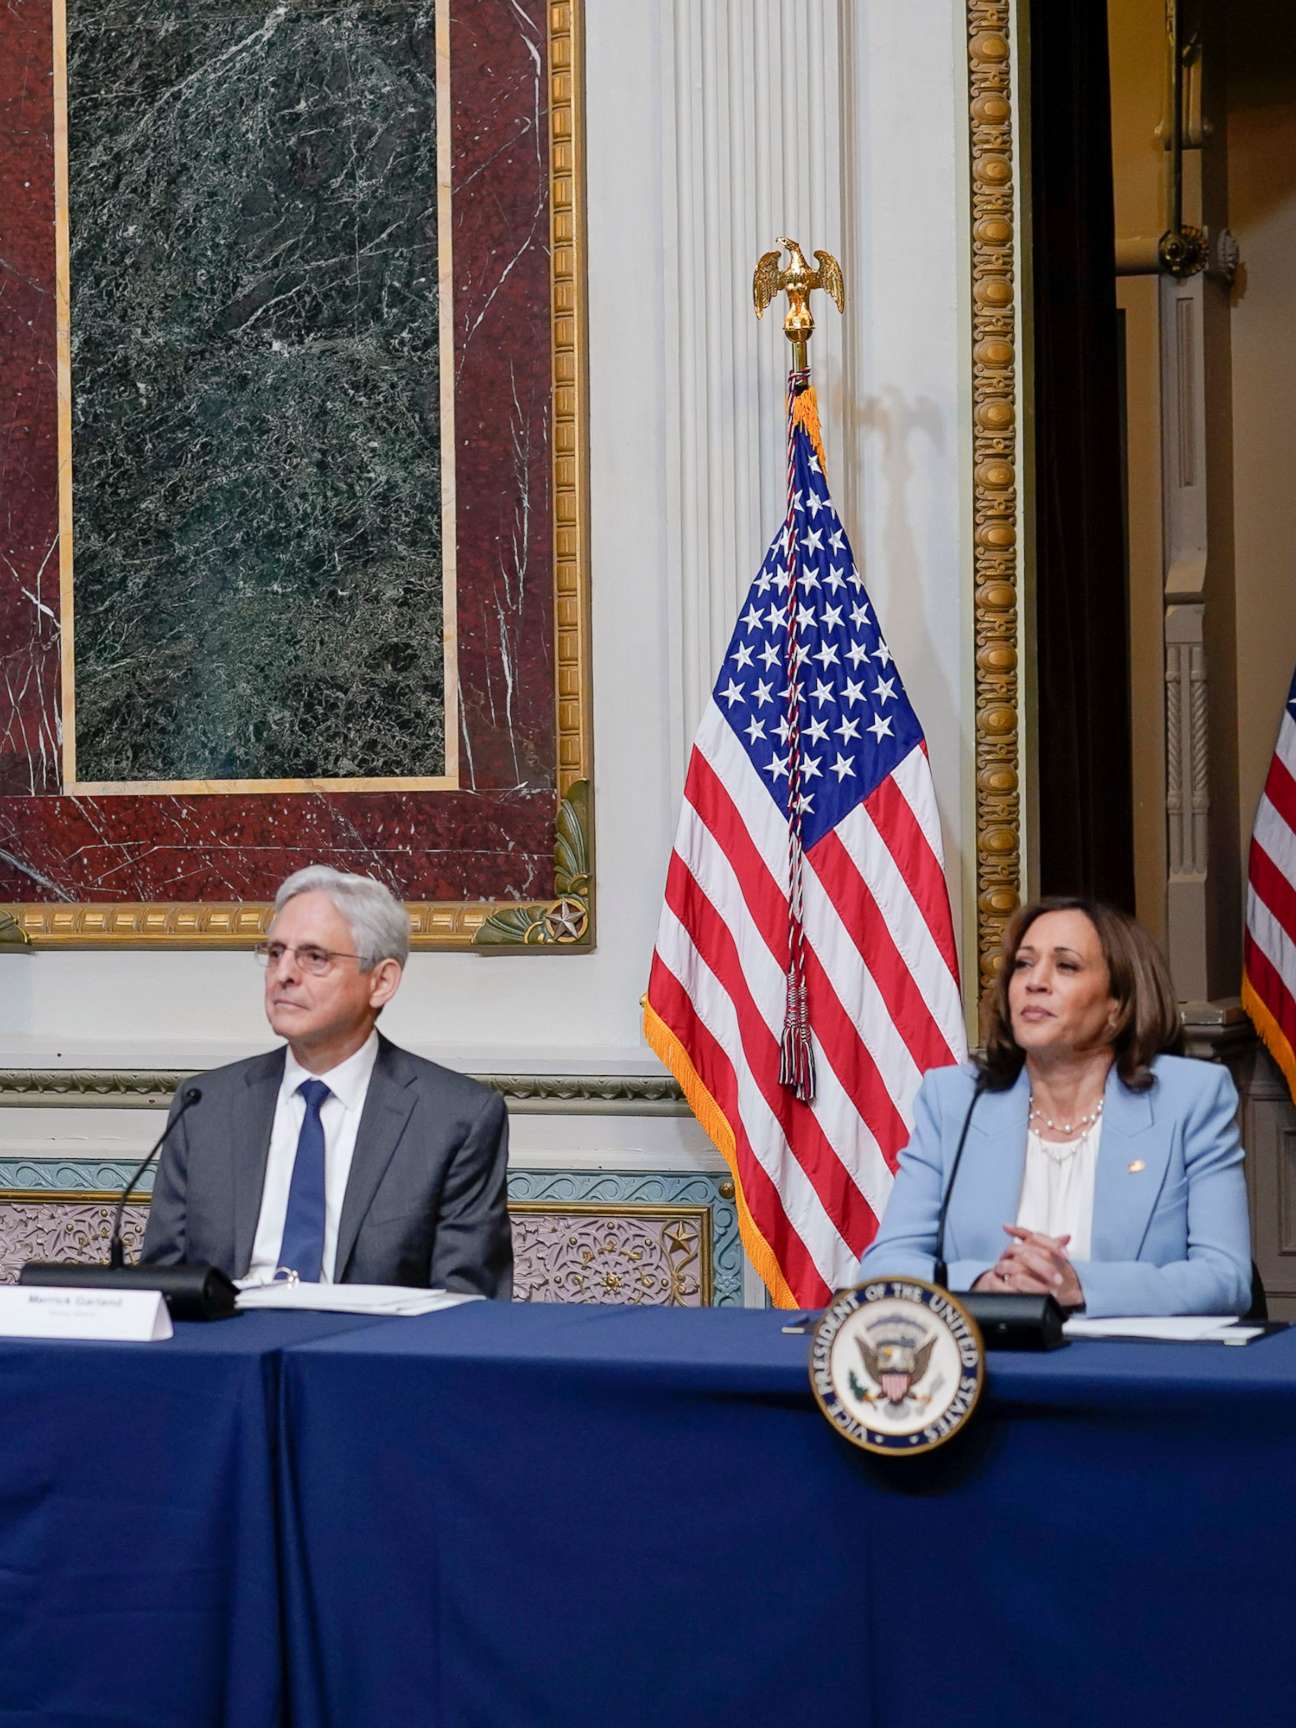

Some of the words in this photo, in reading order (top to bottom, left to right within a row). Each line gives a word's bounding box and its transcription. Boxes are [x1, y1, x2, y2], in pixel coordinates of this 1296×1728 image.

[865, 1284, 886, 1300] OF
[892, 1282, 923, 1300] THE
[813, 1297, 861, 1394] PRESIDENT
[929, 1295, 979, 1367] UNITED
[827, 1400, 868, 1442] VICE
[924, 1377, 977, 1443] STATES
